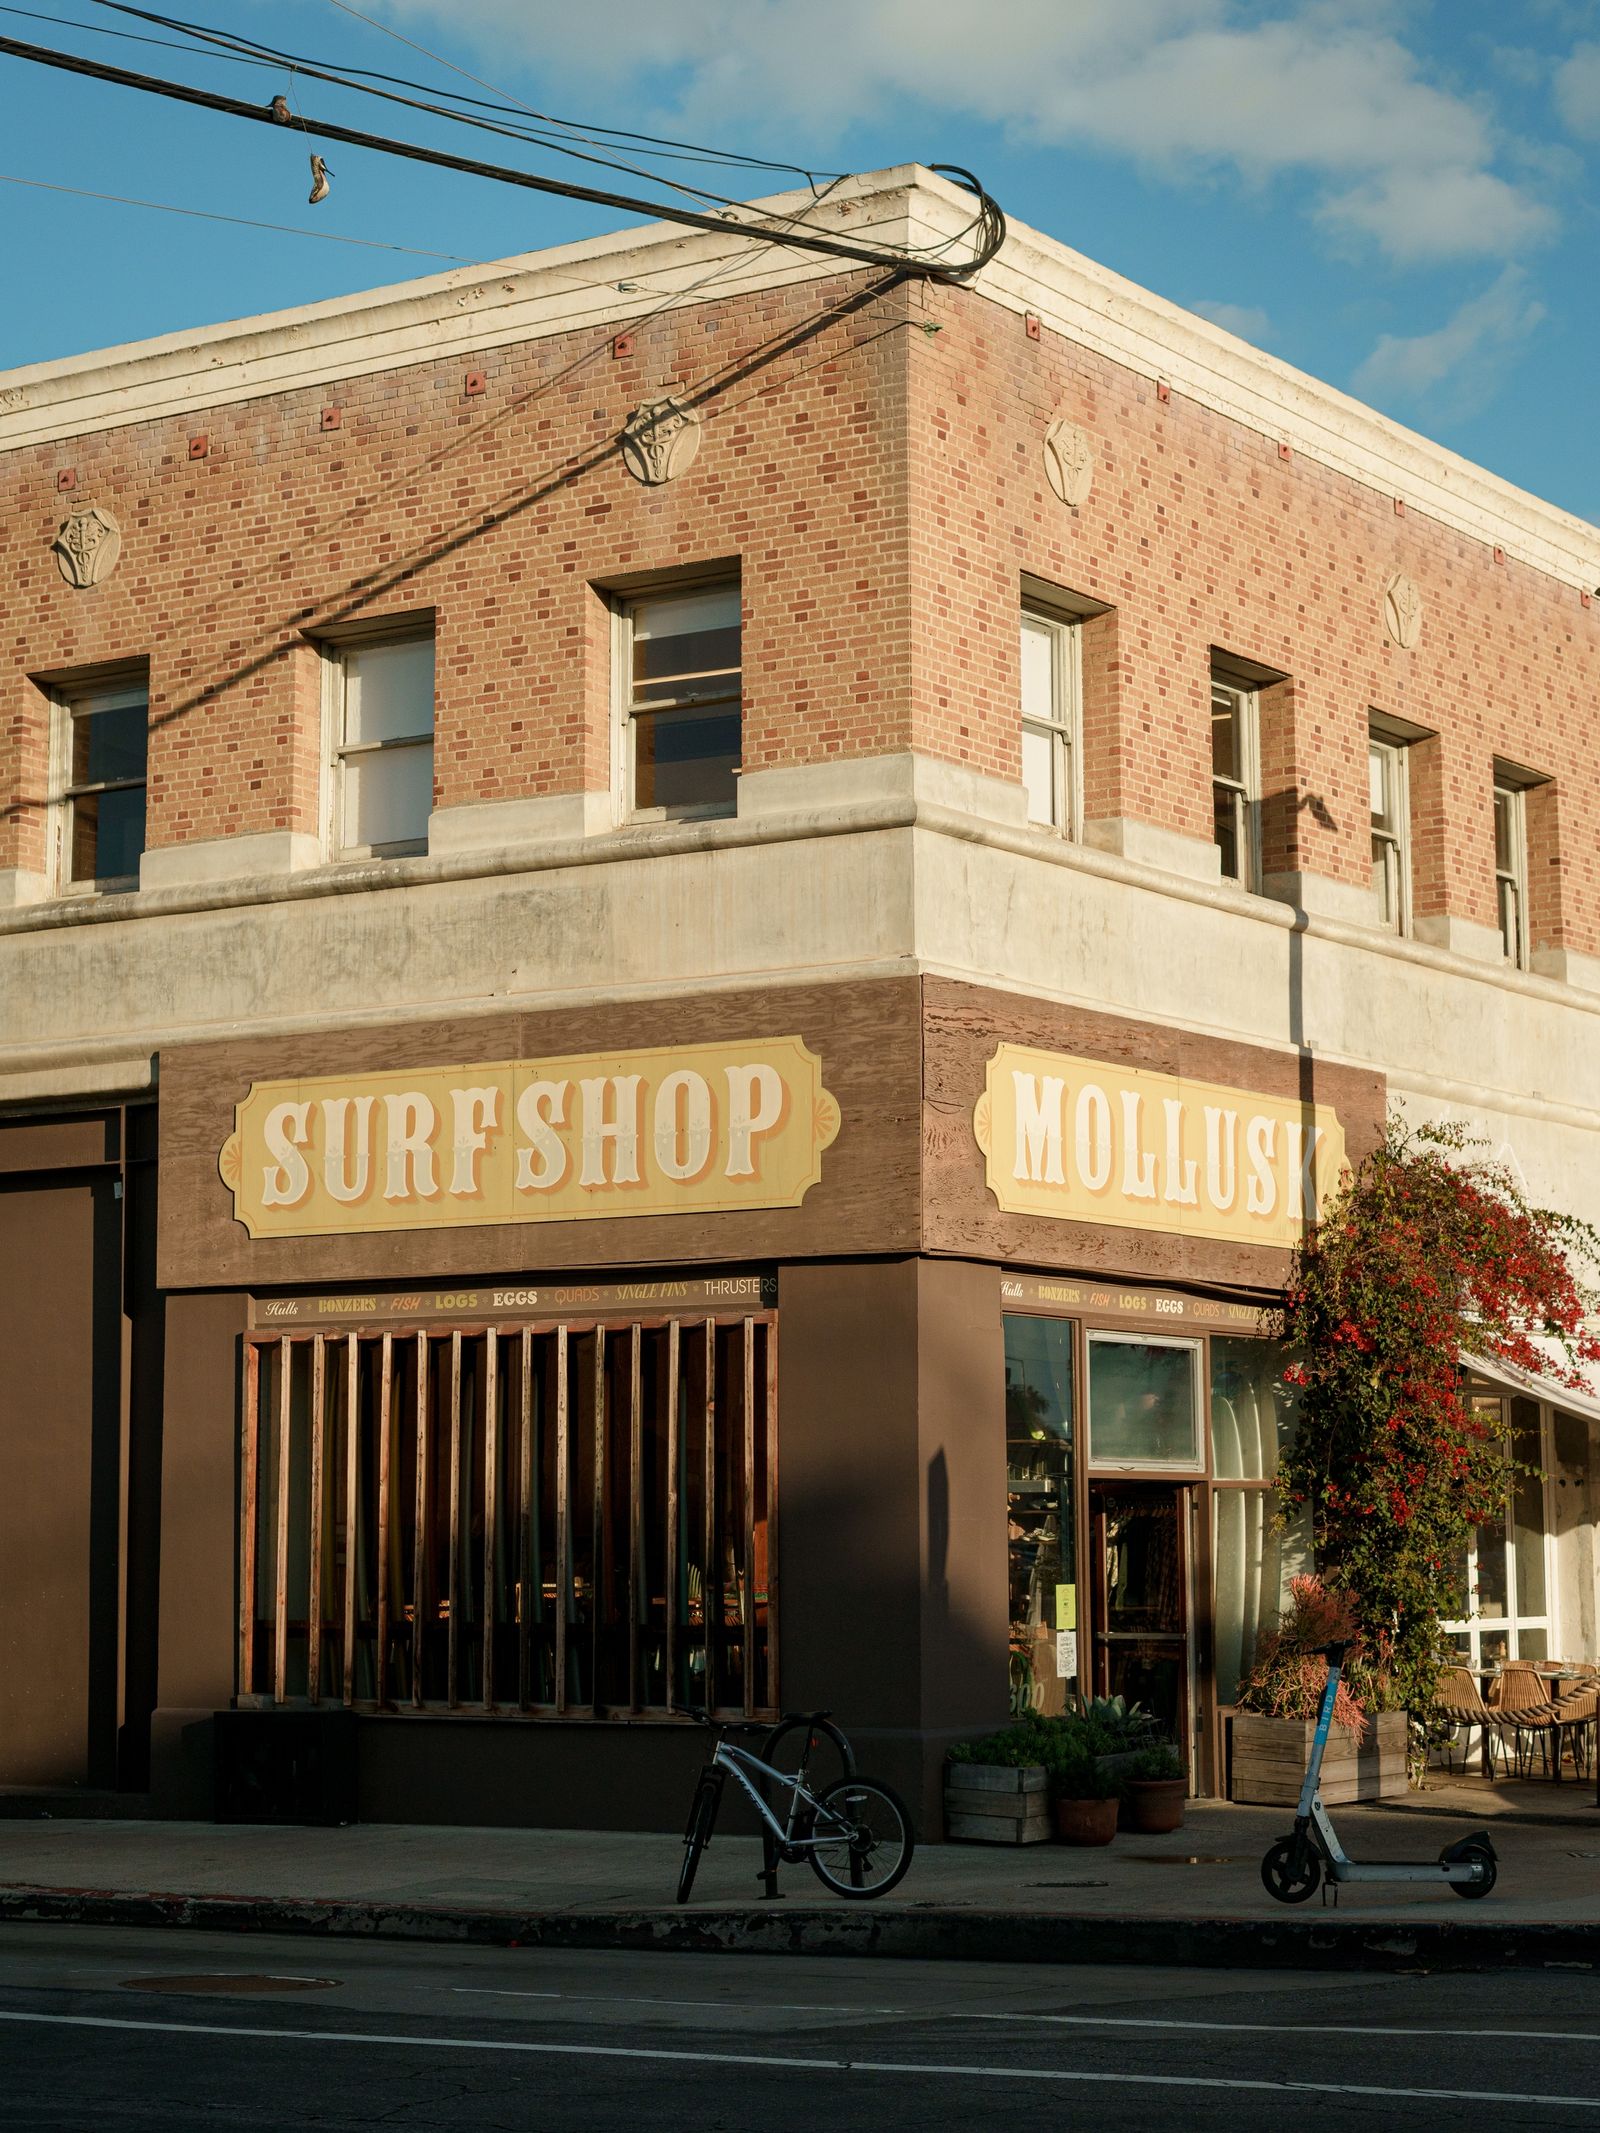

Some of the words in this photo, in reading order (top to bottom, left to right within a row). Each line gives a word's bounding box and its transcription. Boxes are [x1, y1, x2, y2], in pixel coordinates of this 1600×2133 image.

[1011, 1070, 1324, 1222] MOLLUSK
[265, 1301, 299, 1317] Hulls
[318, 1297, 377, 1313] BONZERS
[390, 1296, 422, 1311] FISH
[435, 1293, 478, 1309] LOGS
[493, 1291, 538, 1307] EGGS
[554, 1287, 600, 1305] QUADS
[615, 1283, 657, 1300] SINGLE
[660, 1281, 689, 1298] FINS
[704, 1278, 777, 1295] THRUSTERS
[1000, 1281, 1024, 1298] Hulls
[1038, 1285, 1080, 1304] BONZERS
[1089, 1292, 1111, 1308] FISH
[1119, 1294, 1147, 1311] LOGS
[1155, 1298, 1184, 1314] EGGS
[1193, 1302, 1220, 1318] QUADS
[1319, 1694, 1333, 1732] BIRD
